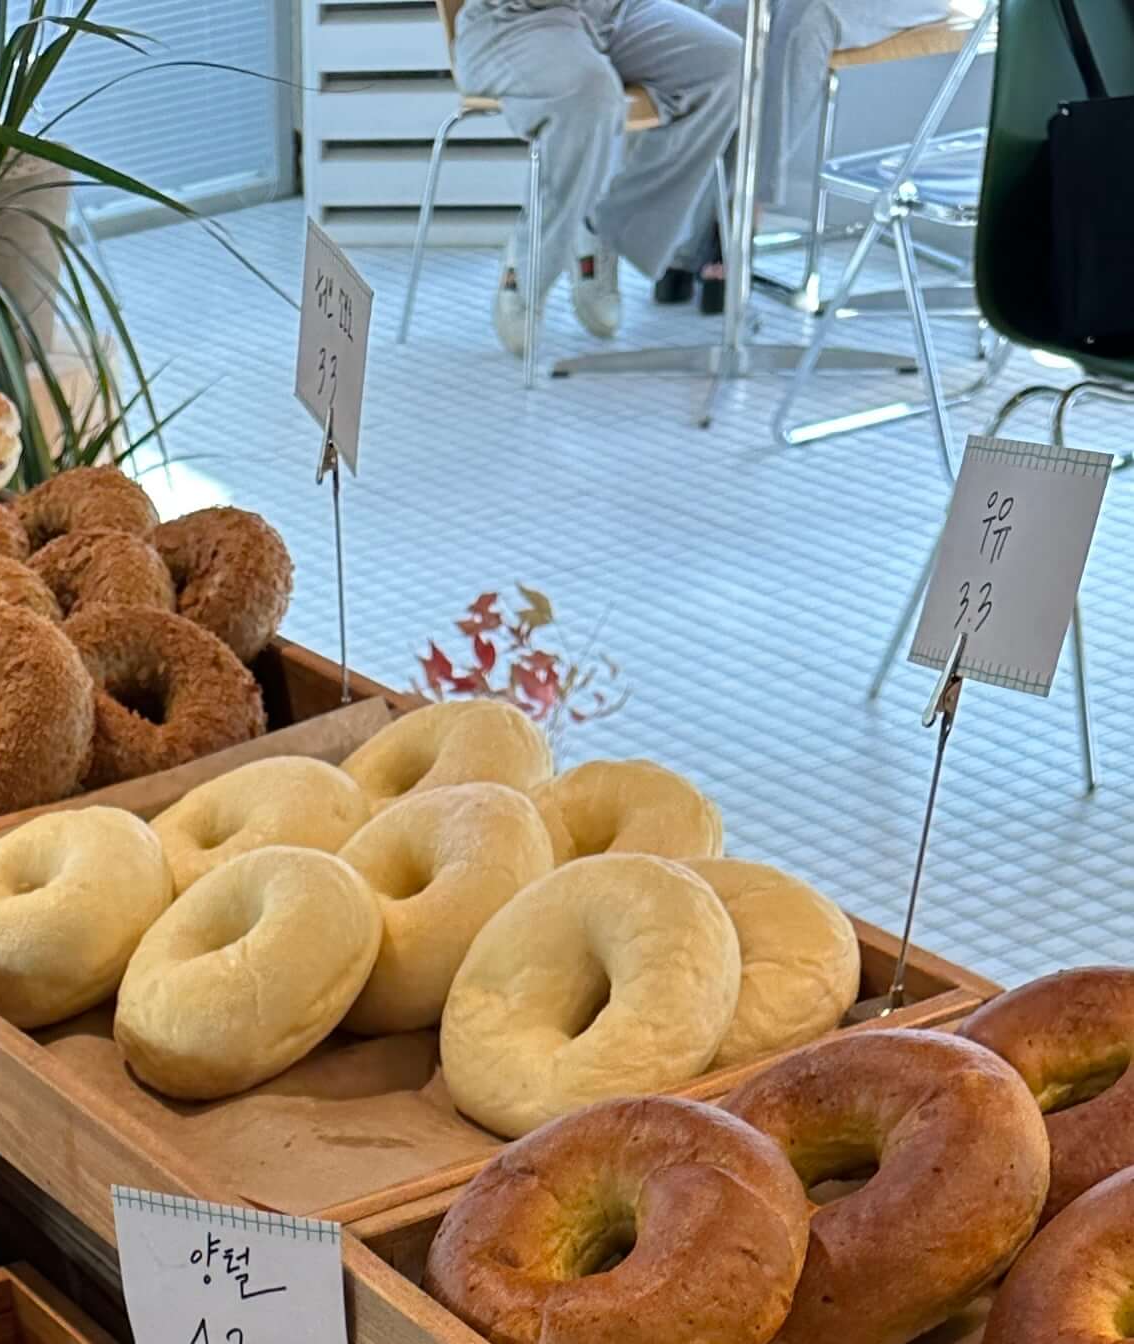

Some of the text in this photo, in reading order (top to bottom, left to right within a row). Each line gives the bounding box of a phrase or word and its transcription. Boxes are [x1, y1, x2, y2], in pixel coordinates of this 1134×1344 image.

[979, 490, 1015, 565] 우유
[954, 581, 993, 633] 3.3
[189, 1231, 287, 1300] 양털
